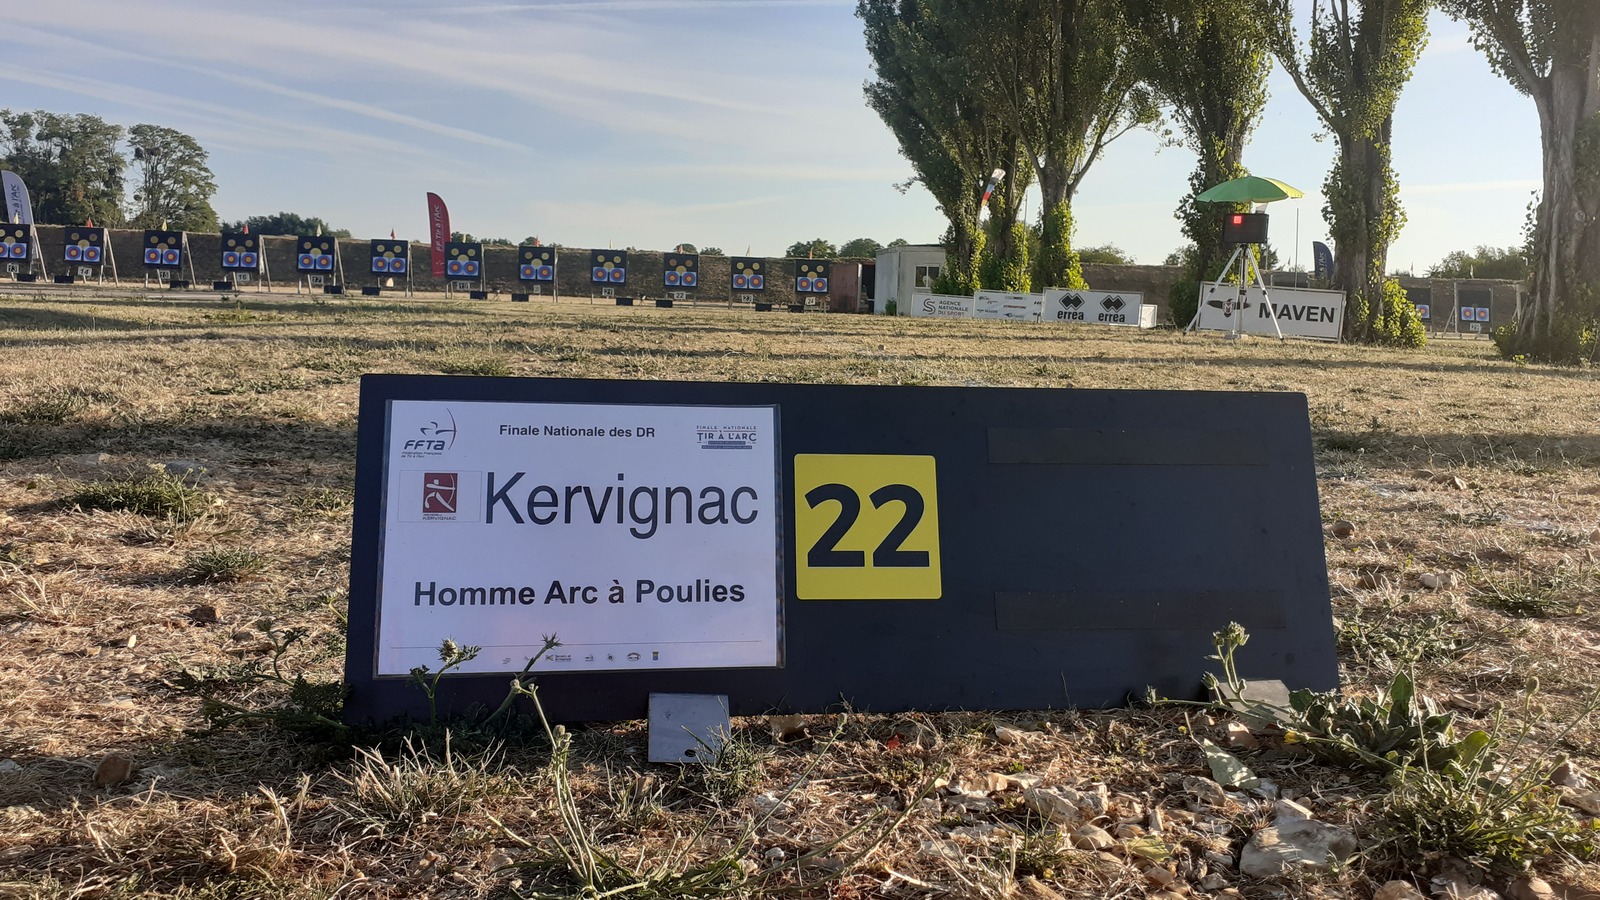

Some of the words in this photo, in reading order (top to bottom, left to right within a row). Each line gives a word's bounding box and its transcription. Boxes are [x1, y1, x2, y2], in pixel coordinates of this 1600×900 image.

[1259, 303, 1335, 323] MAVEN
[499, 425, 540, 435] Finale
[544, 426, 605, 437] Nationale
[609, 427, 632, 437] des
[636, 428, 655, 437] DR
[697, 433, 714, 441] TIR
[718, 430, 724, 439] À
[728, 433, 757, 441] L'ARC
[486, 472, 758, 539] Kervignac
[804, 483, 930, 567] 22
[414, 581, 535, 606] Homme
[544, 580, 598, 604] Arc
[608, 580, 624, 604] à
[636, 579, 745, 603] Poulies
